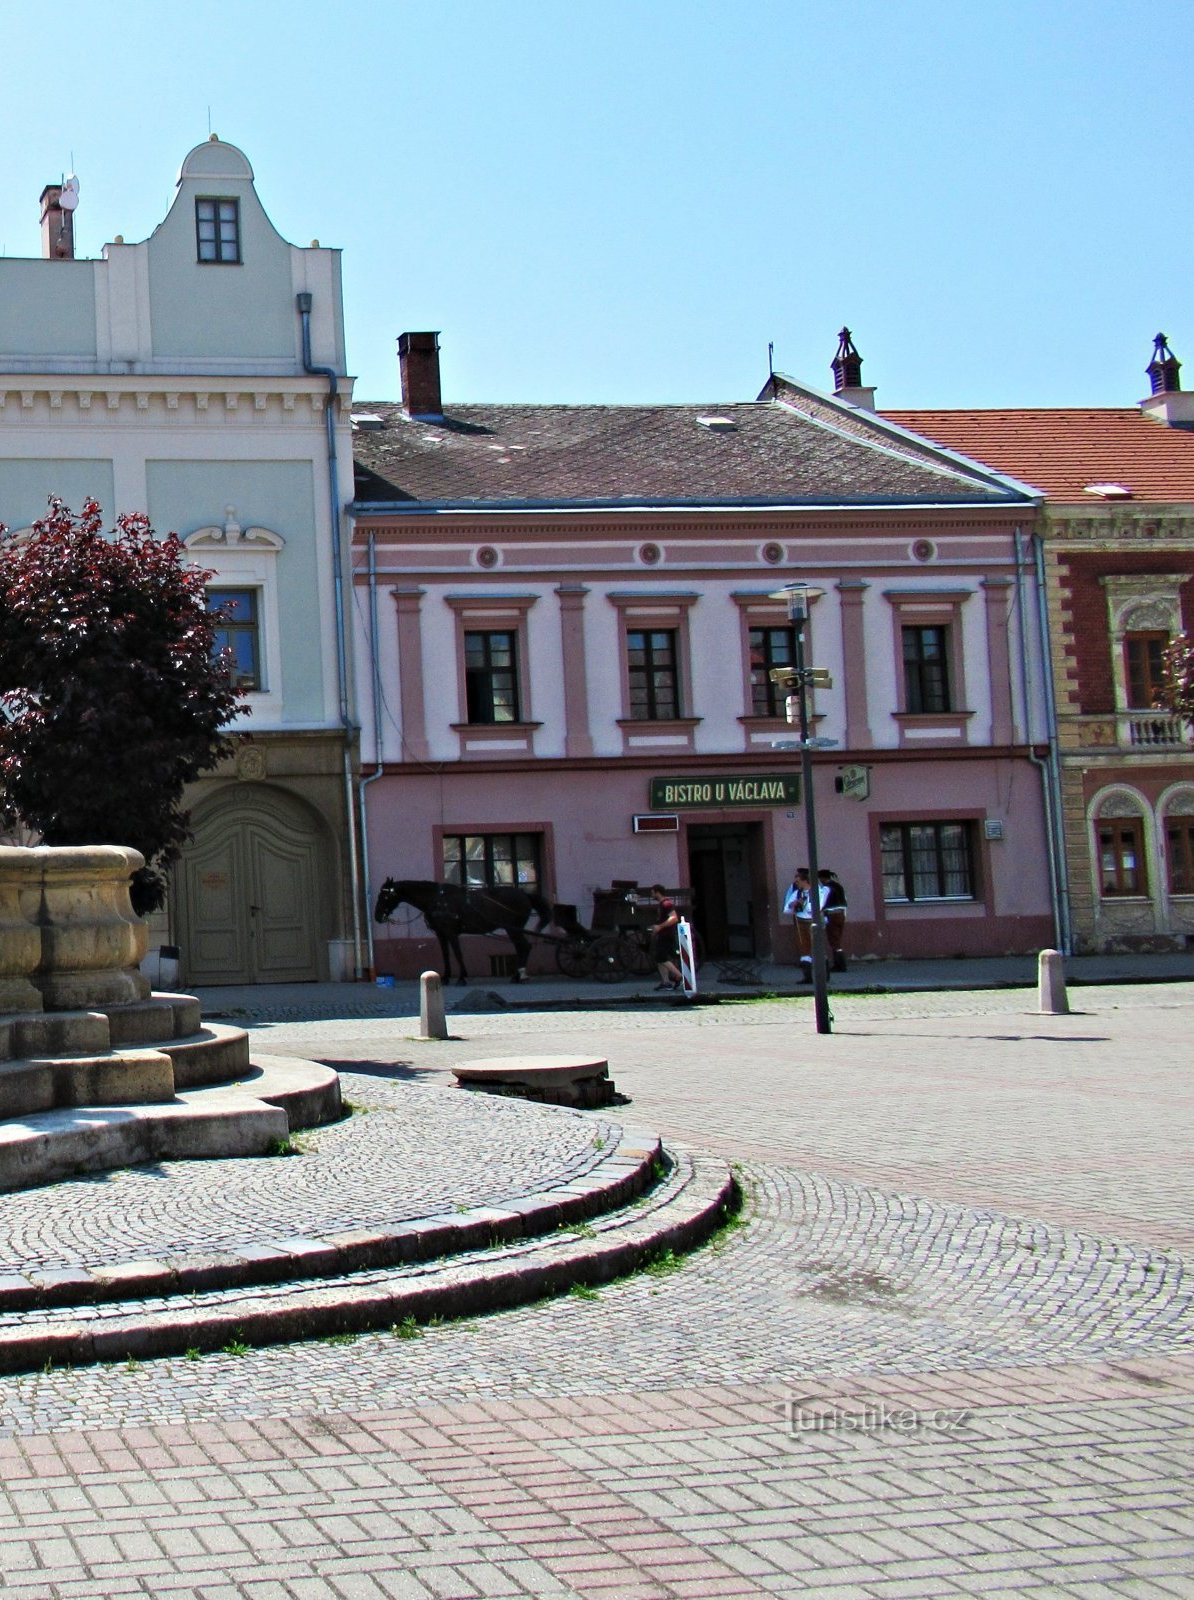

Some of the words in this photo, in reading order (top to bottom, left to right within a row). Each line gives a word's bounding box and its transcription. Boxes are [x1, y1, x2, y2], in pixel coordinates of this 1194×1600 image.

[665, 784, 711, 803] BISTRO
[715, 784, 725, 801] U
[728, 779, 786, 801] VÁCLAVA
